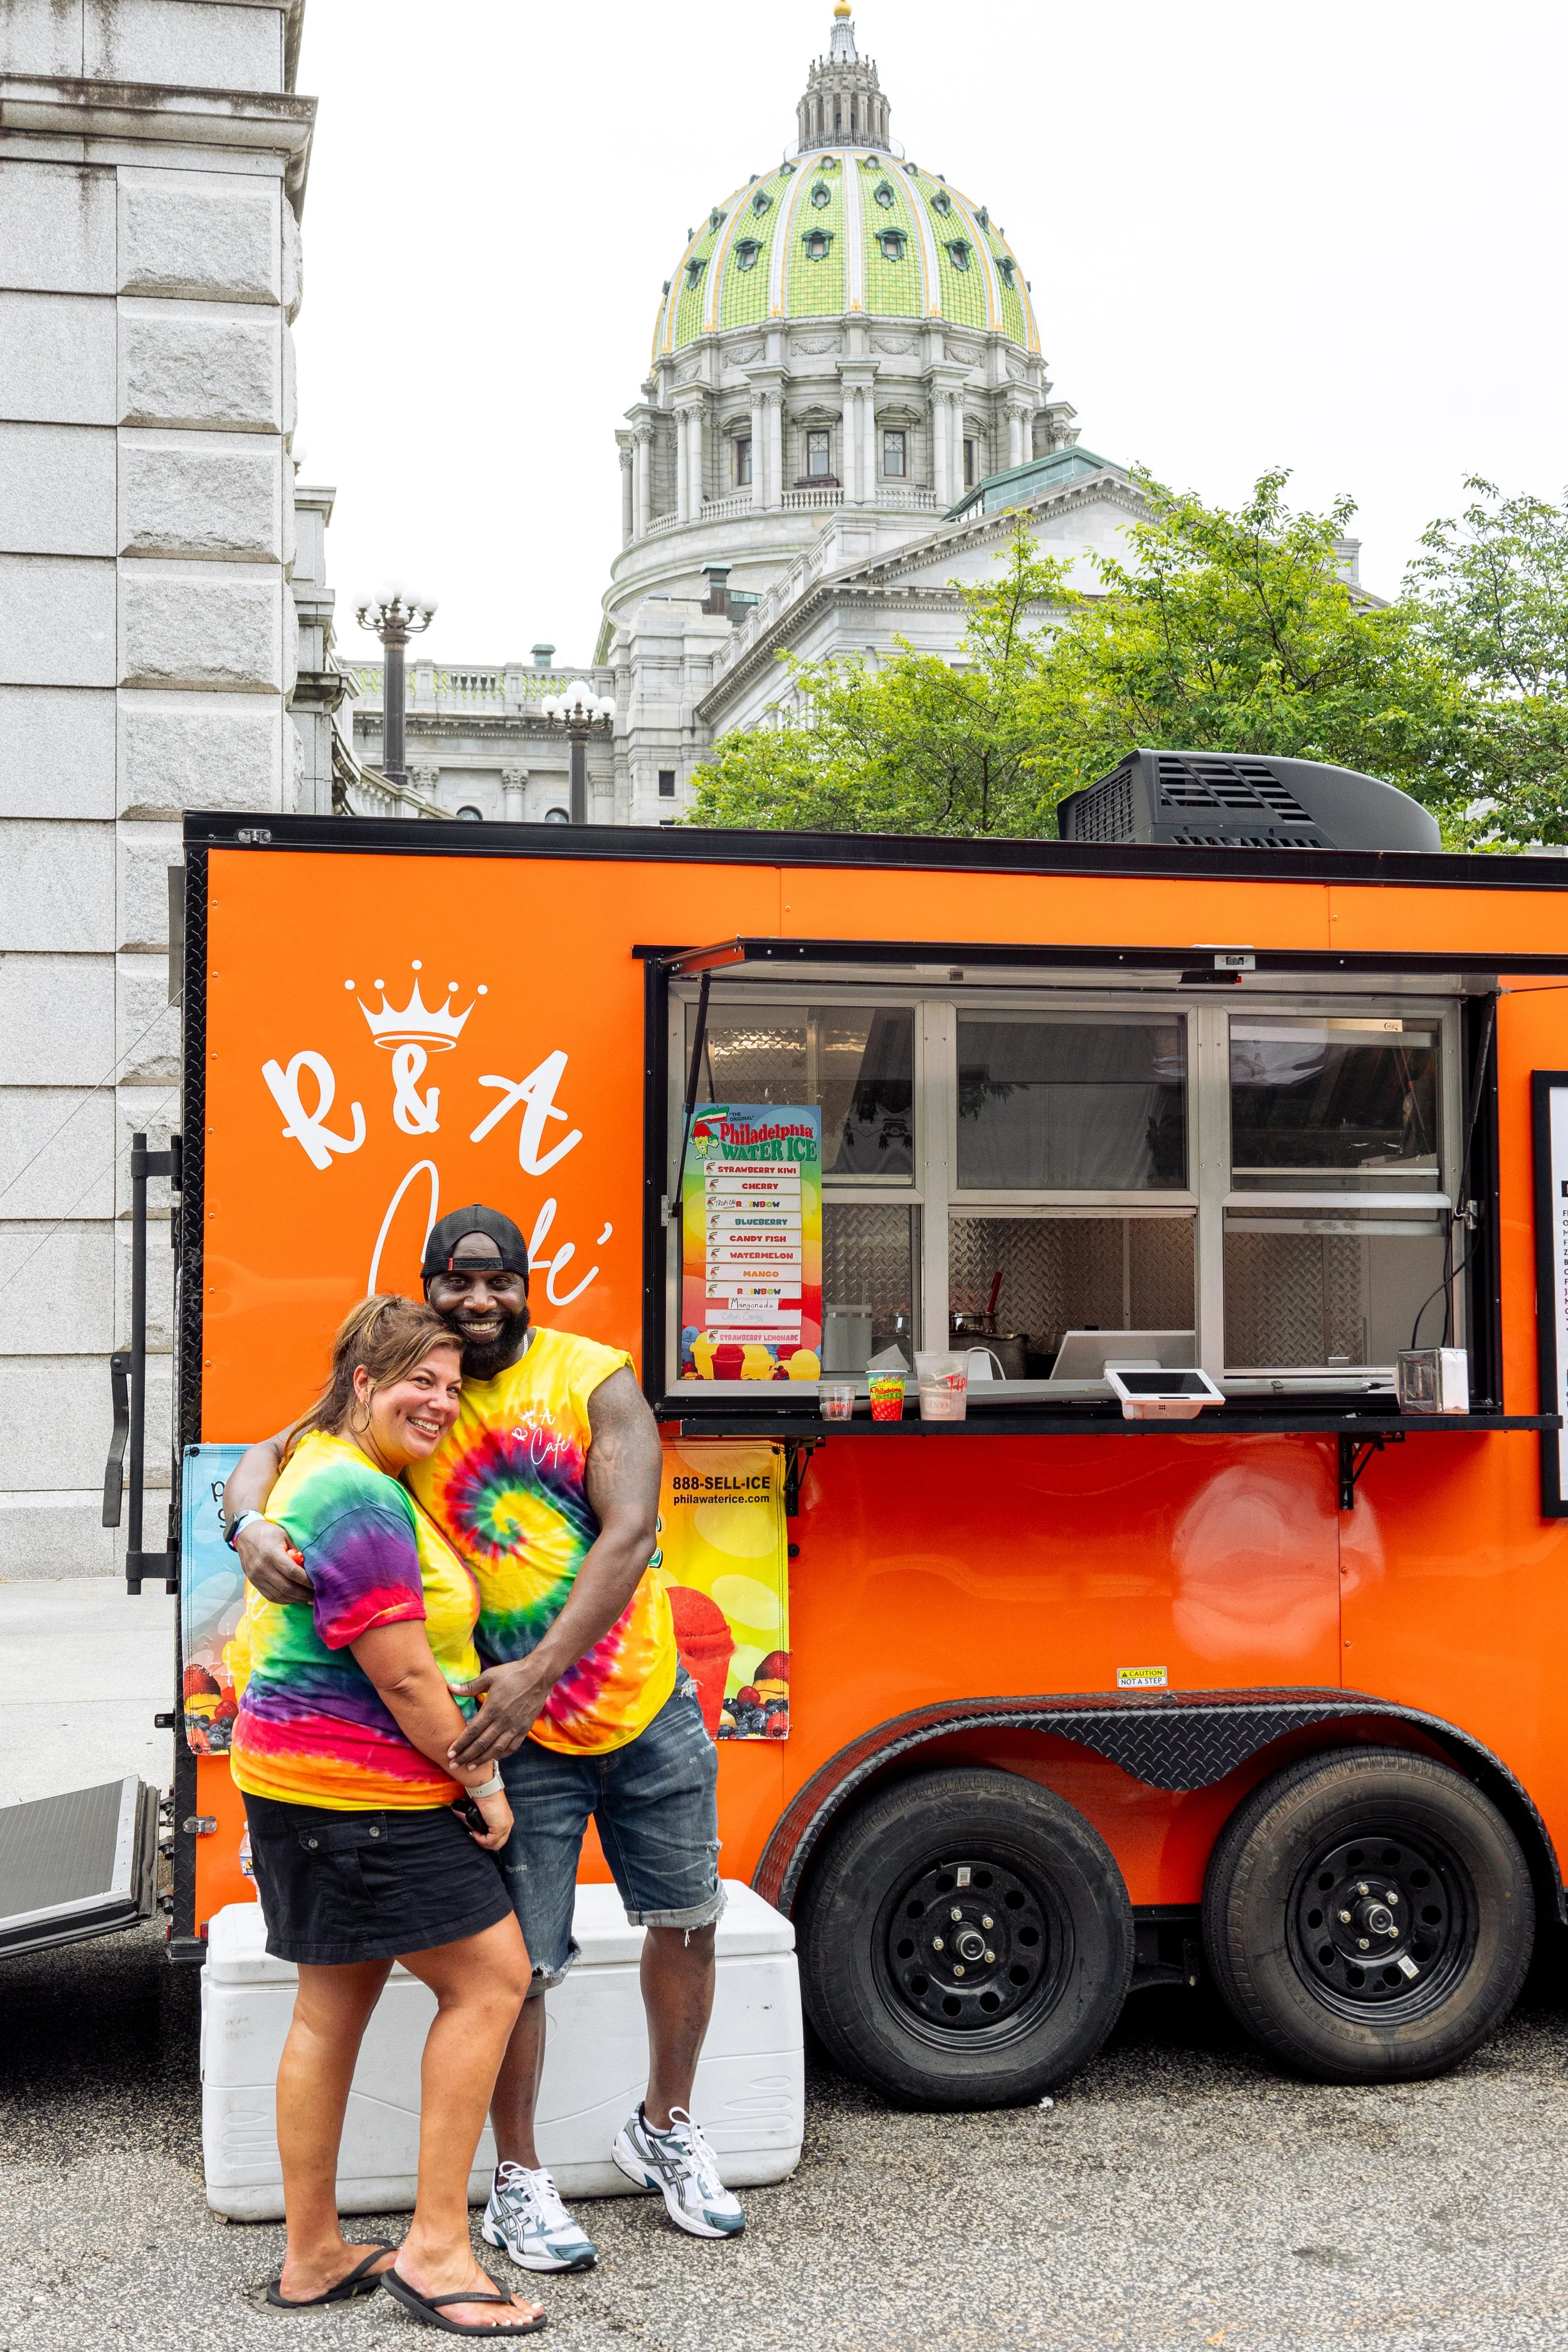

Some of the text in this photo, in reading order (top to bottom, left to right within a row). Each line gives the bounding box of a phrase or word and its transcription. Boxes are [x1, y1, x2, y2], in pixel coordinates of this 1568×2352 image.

[262, 1043, 583, 1176] R & A
[719, 1123, 813, 1146] Philadelphia
[721, 1136, 817, 1162] WATER ICE
[718, 1166, 775, 1174] STRAWBERRY
[673, 1476, 771, 1490] 888-SELL-ICE
[674, 1494, 770, 1506] philawaterice.com
